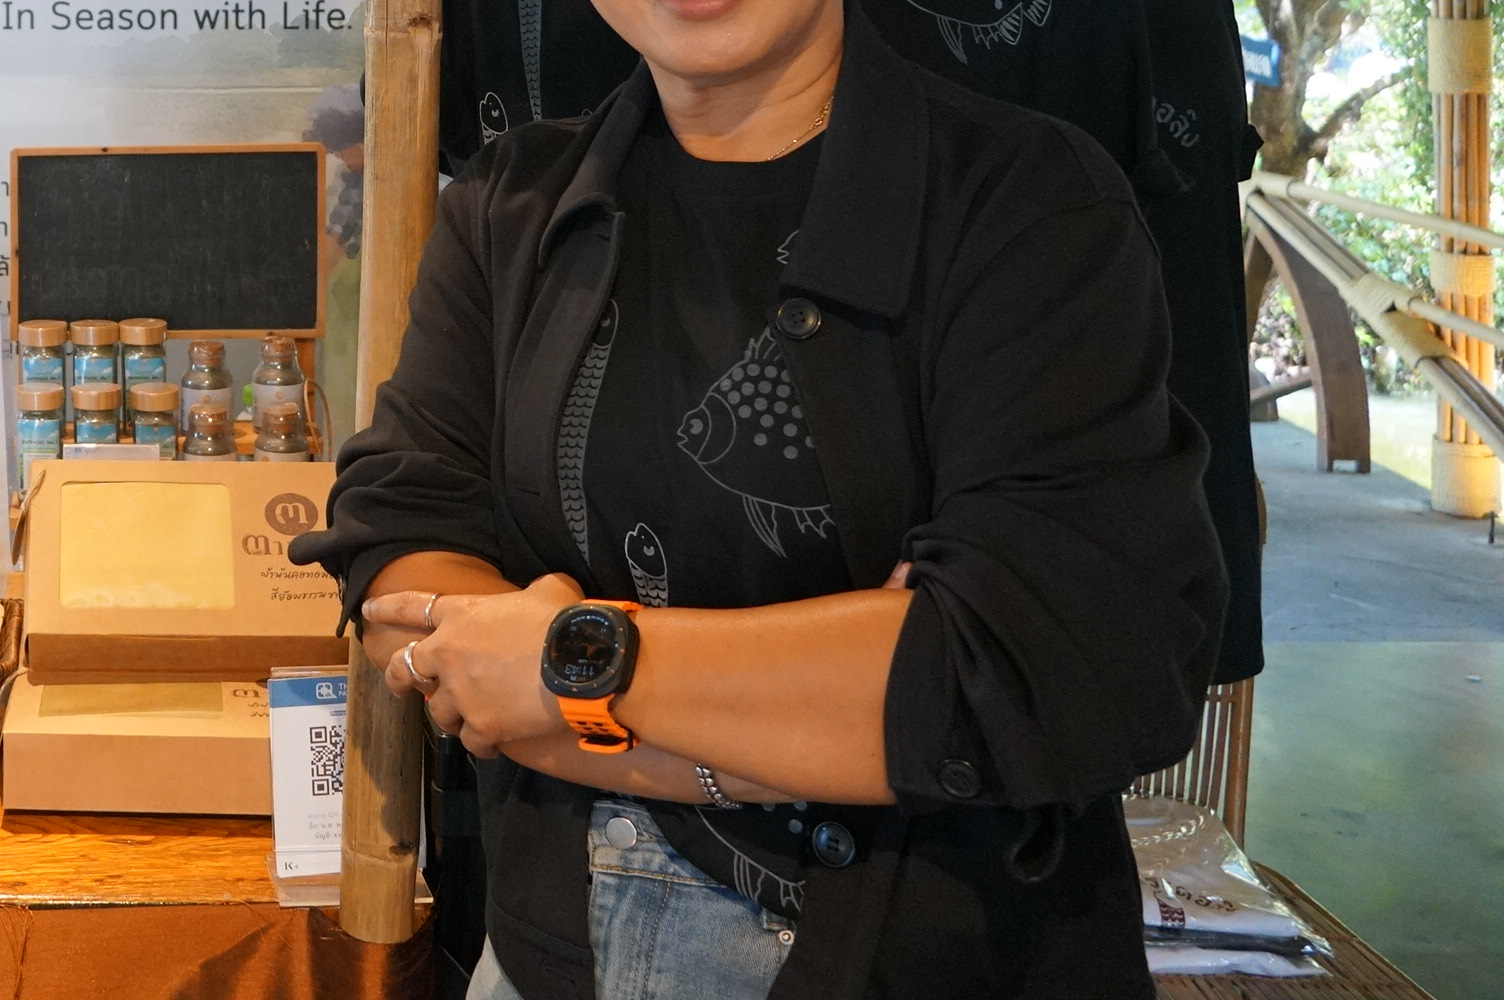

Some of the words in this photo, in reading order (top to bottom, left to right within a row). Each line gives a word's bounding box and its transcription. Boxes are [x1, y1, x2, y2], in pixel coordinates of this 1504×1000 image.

[2, 1, 35, 30] In
[51, 1, 178, 31] Season
[193, 0, 266, 31] with
[282, 0, 353, 31] Life.
